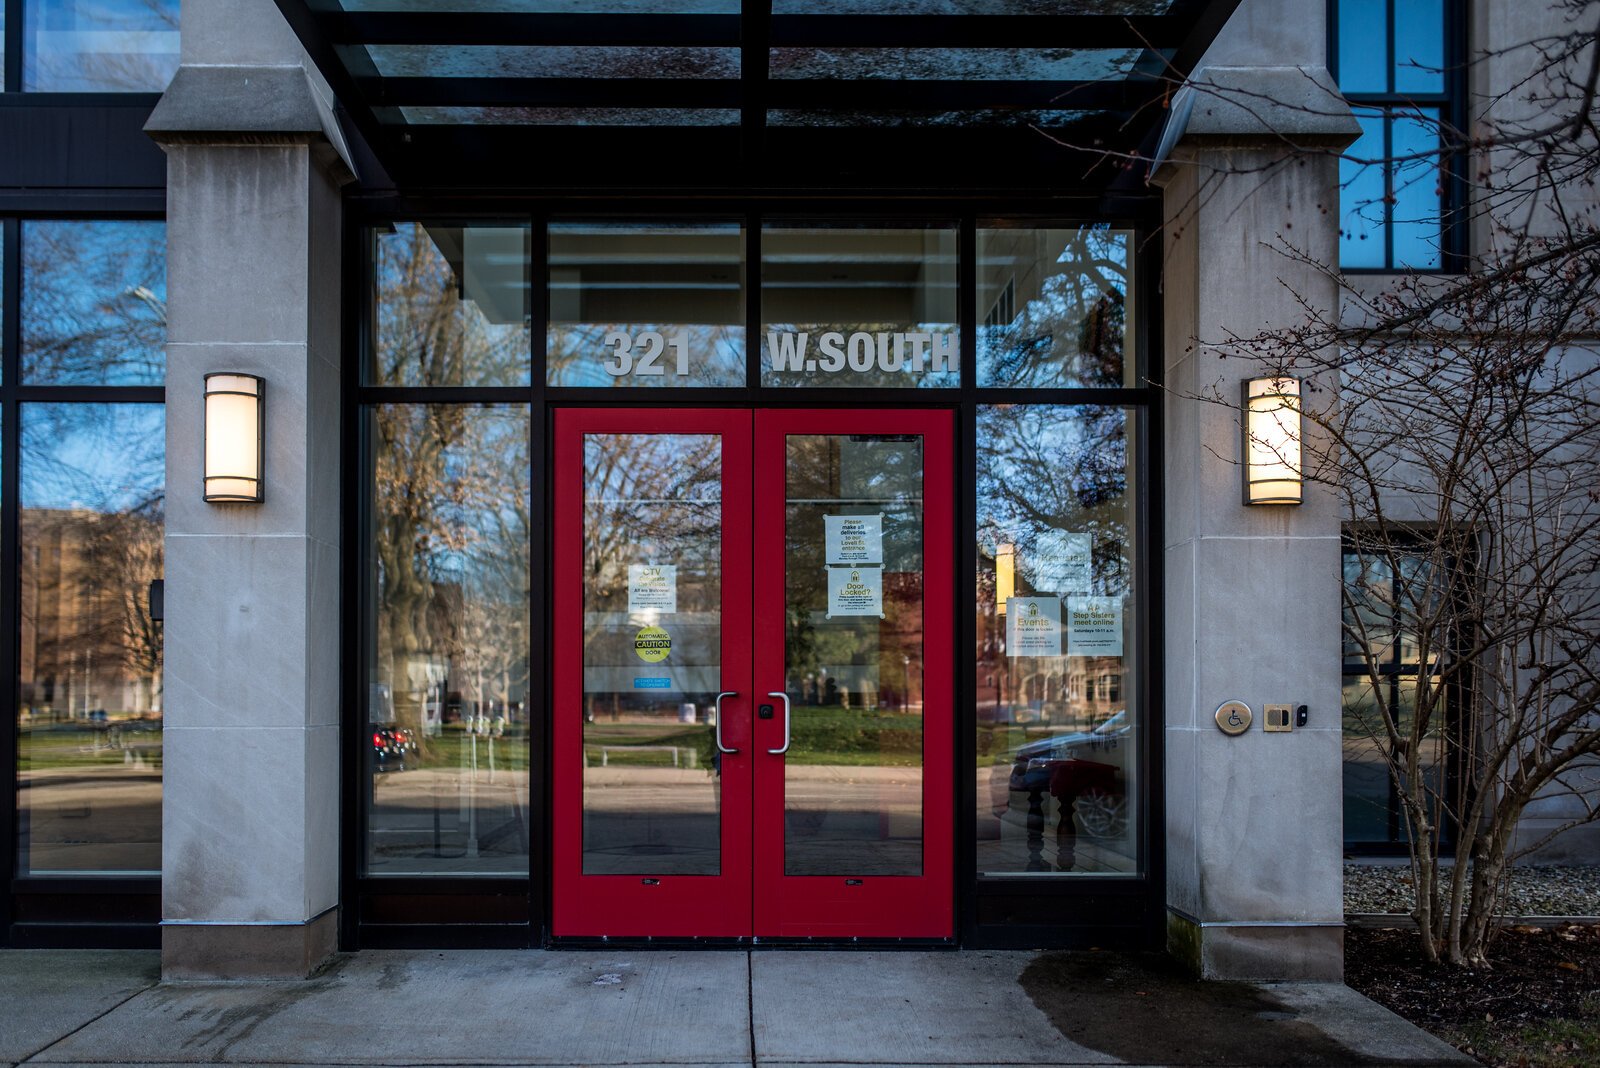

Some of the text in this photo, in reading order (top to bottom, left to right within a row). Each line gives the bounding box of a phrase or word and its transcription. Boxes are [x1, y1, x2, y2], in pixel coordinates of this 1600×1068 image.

[604, 332, 959, 376] 321 W.SOUTH
[642, 568, 661, 576] CTV
[1017, 618, 1050, 626] Events
[636, 640, 670, 648] CAUTION
